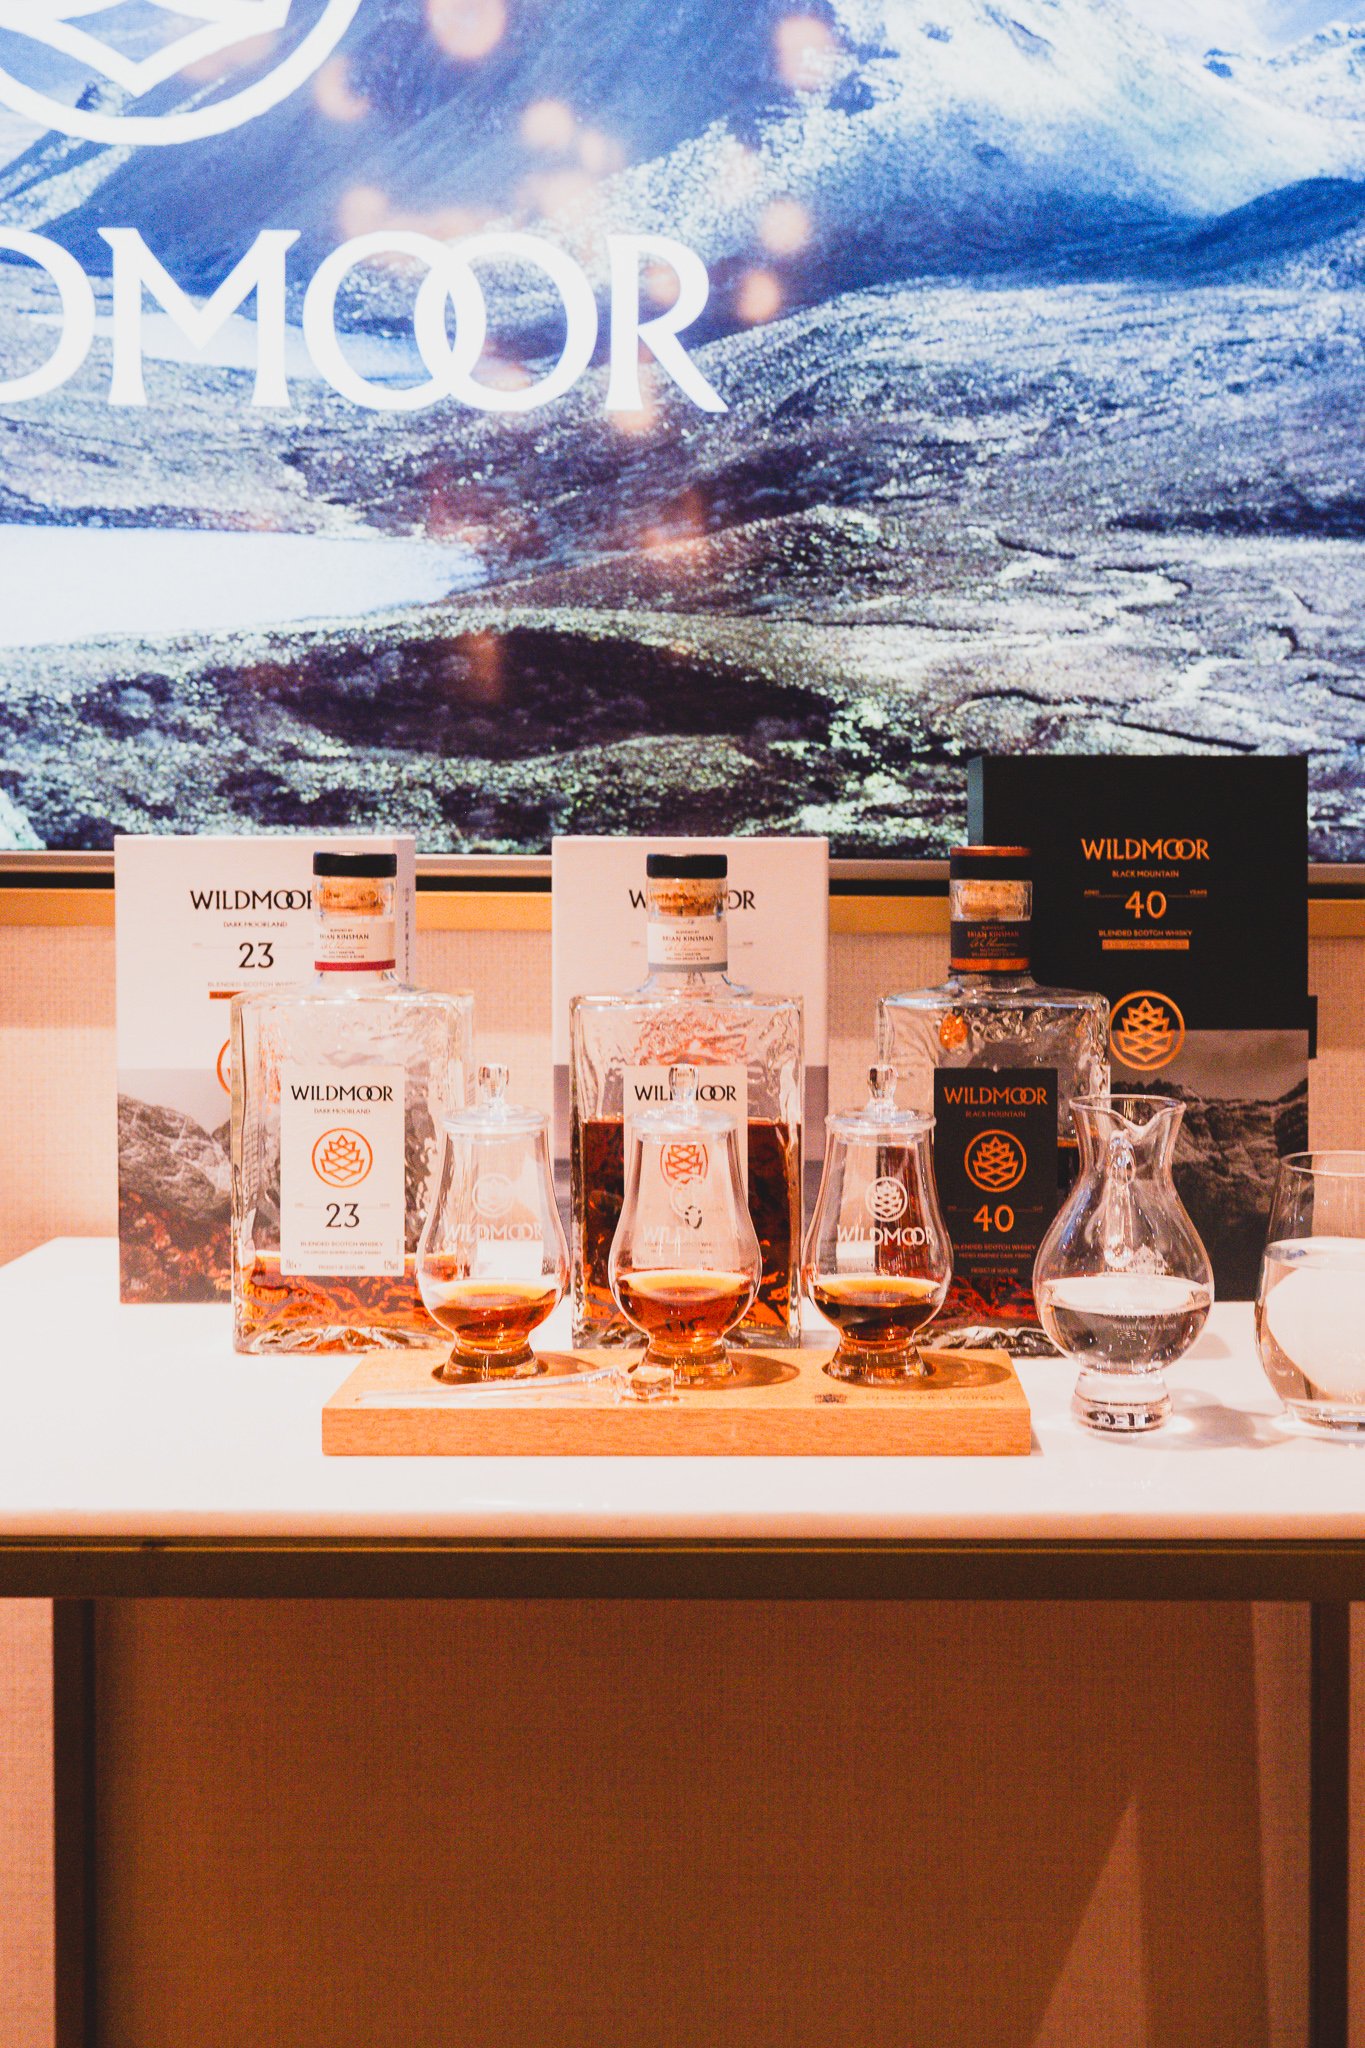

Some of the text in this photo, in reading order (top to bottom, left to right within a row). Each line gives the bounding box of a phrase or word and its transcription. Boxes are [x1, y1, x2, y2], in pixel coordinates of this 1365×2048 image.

[1081, 838, 1210, 860] WILDMOOR
[1112, 870, 1179, 878] BLACK MOUNTAIN
[1125, 890, 1167, 919] 40
[238, 942, 275, 968] 23
[291, 1085, 394, 1102] WILDMOOR
[634, 1085, 737, 1101] WILOOR
[943, 1086, 1048, 1105] WILDMOOR
[326, 1203, 360, 1228] 23
[973, 1204, 1015, 1232] 40
[444, 1223, 543, 1243] WILDMOOR
[837, 1224, 935, 1246] WILDMOOR
